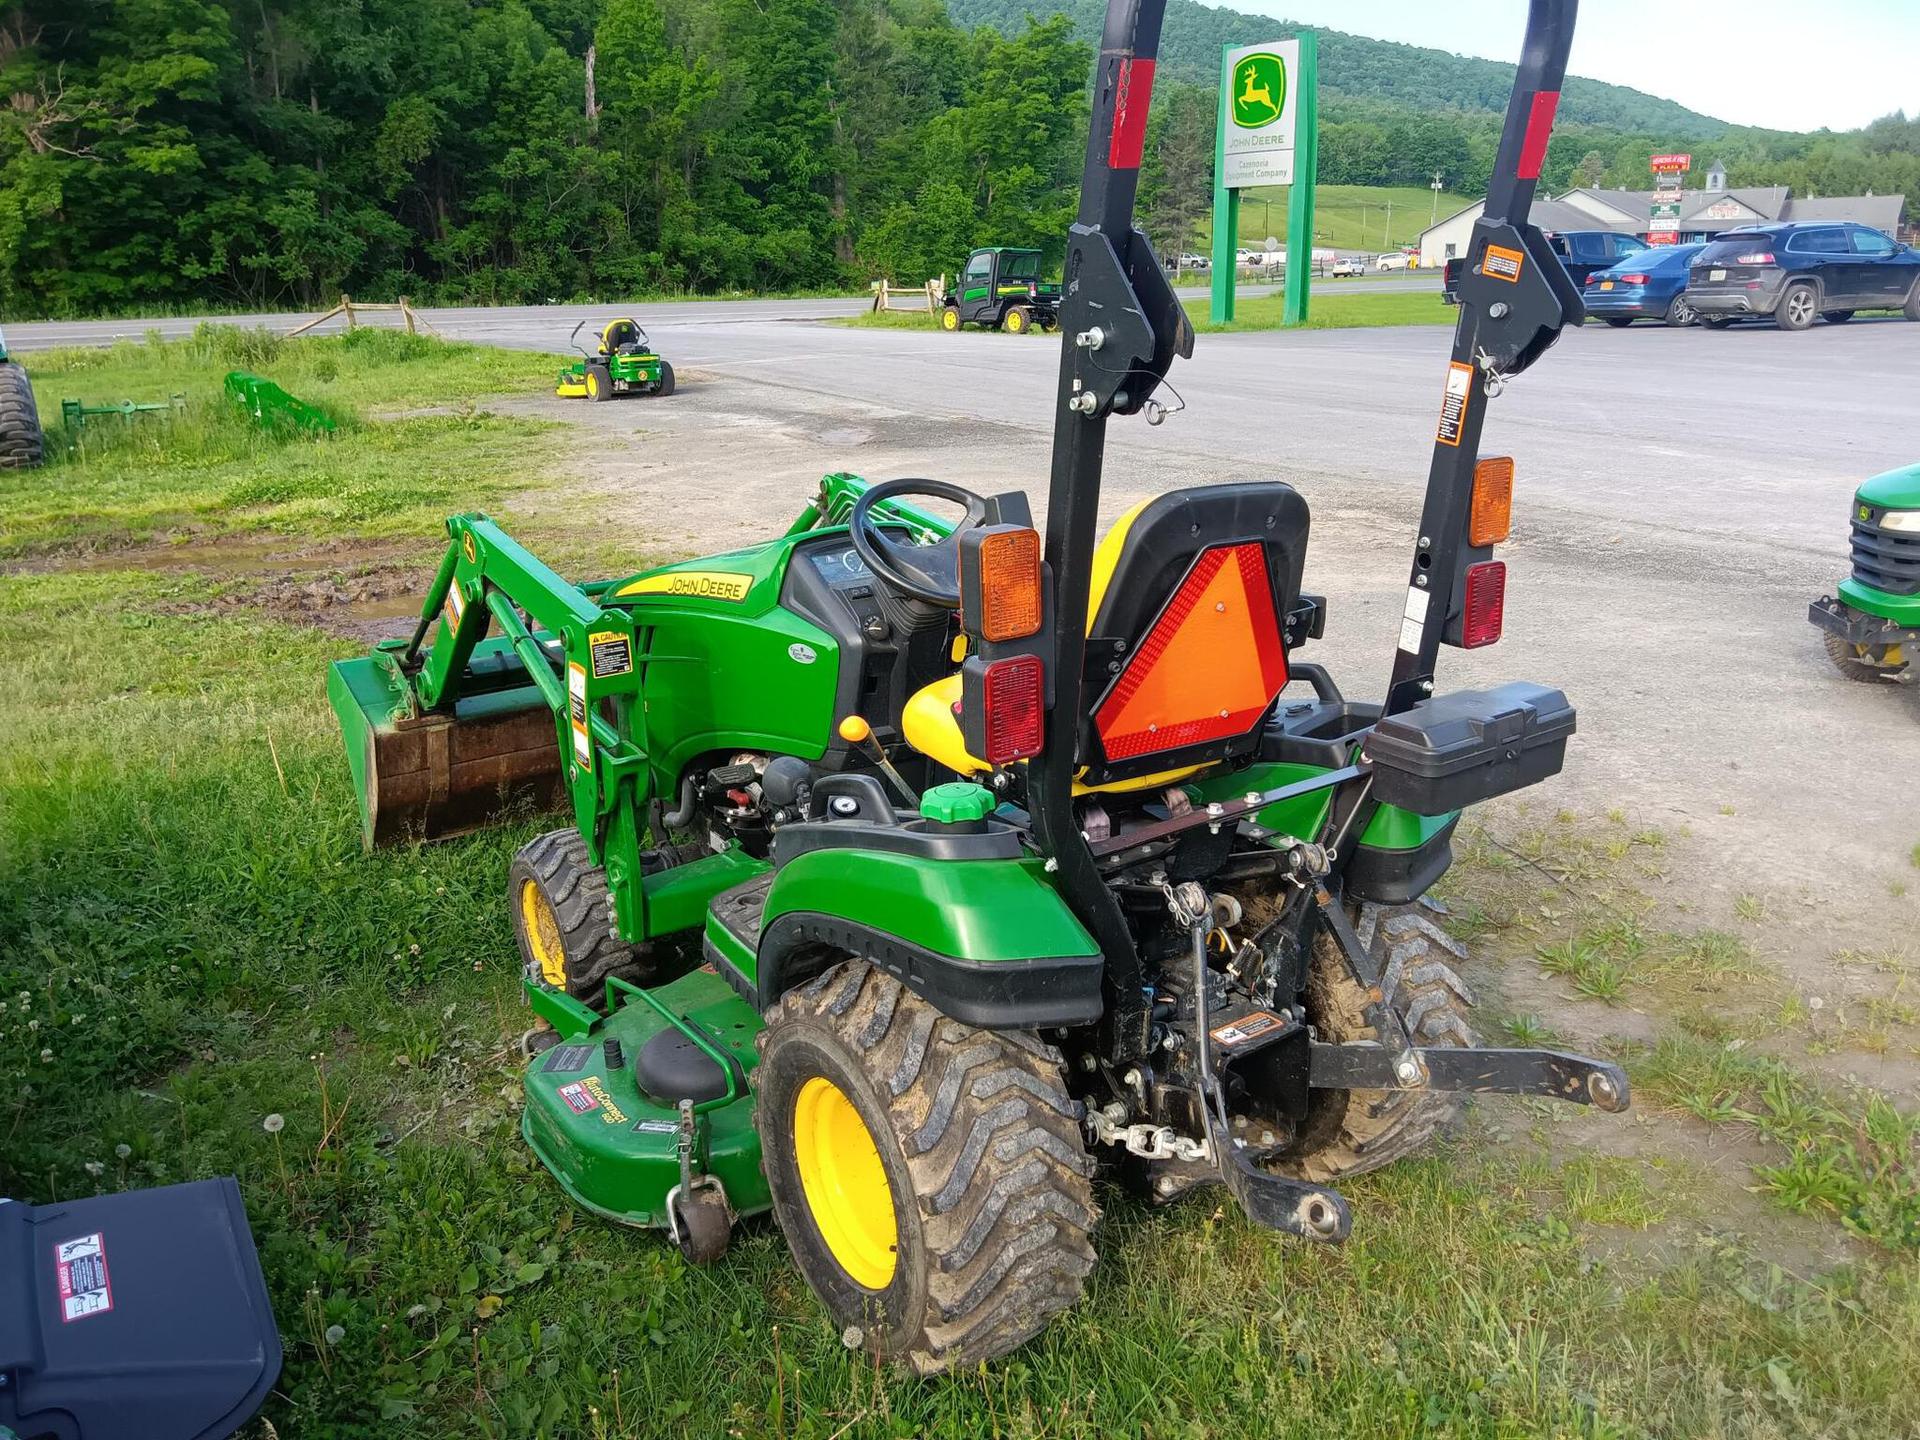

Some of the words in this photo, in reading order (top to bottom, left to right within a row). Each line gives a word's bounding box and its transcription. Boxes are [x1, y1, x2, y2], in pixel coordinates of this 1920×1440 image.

[1229, 136, 1250, 148] JOHN
[1251, 134, 1285, 146] DEERE
[1255, 169, 1288, 179] Company
[668, 576, 699, 592] JOHN
[700, 577, 742, 598] DEERE
[581, 1076, 629, 1124] AutoConnect
